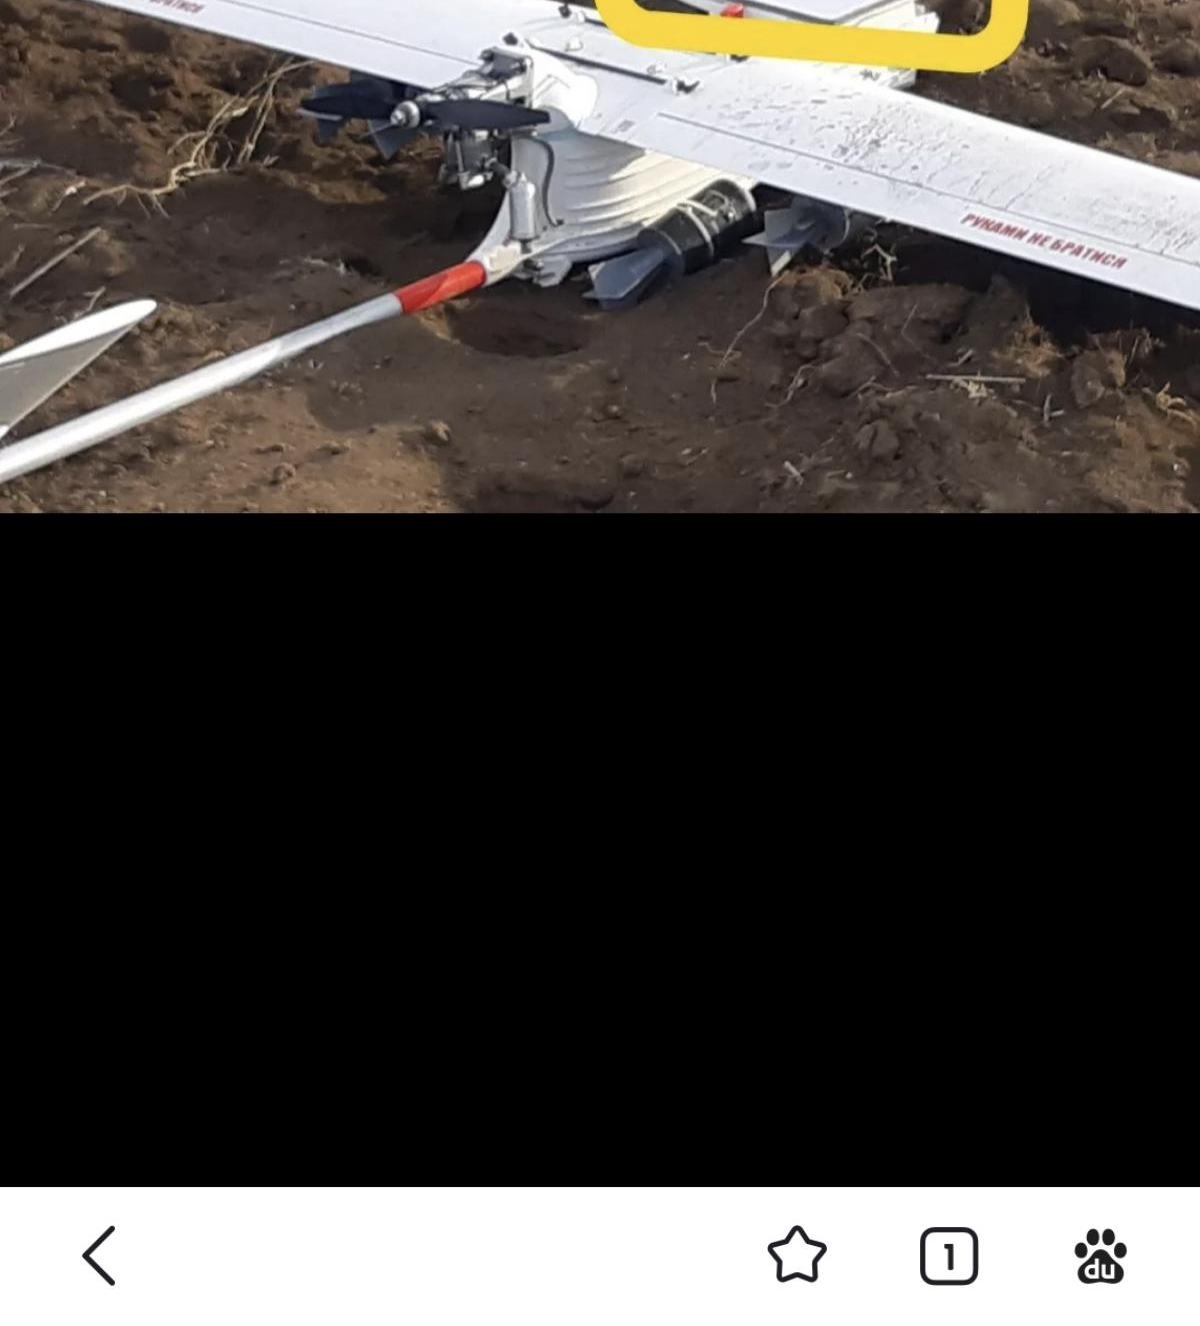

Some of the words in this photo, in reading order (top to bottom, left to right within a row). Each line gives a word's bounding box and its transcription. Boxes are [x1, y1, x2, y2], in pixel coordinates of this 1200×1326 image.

[960, 213, 1029, 241] РУКАМИ
[1026, 232, 1052, 246] НЕ
[943, 1243, 955, 1271] 1
